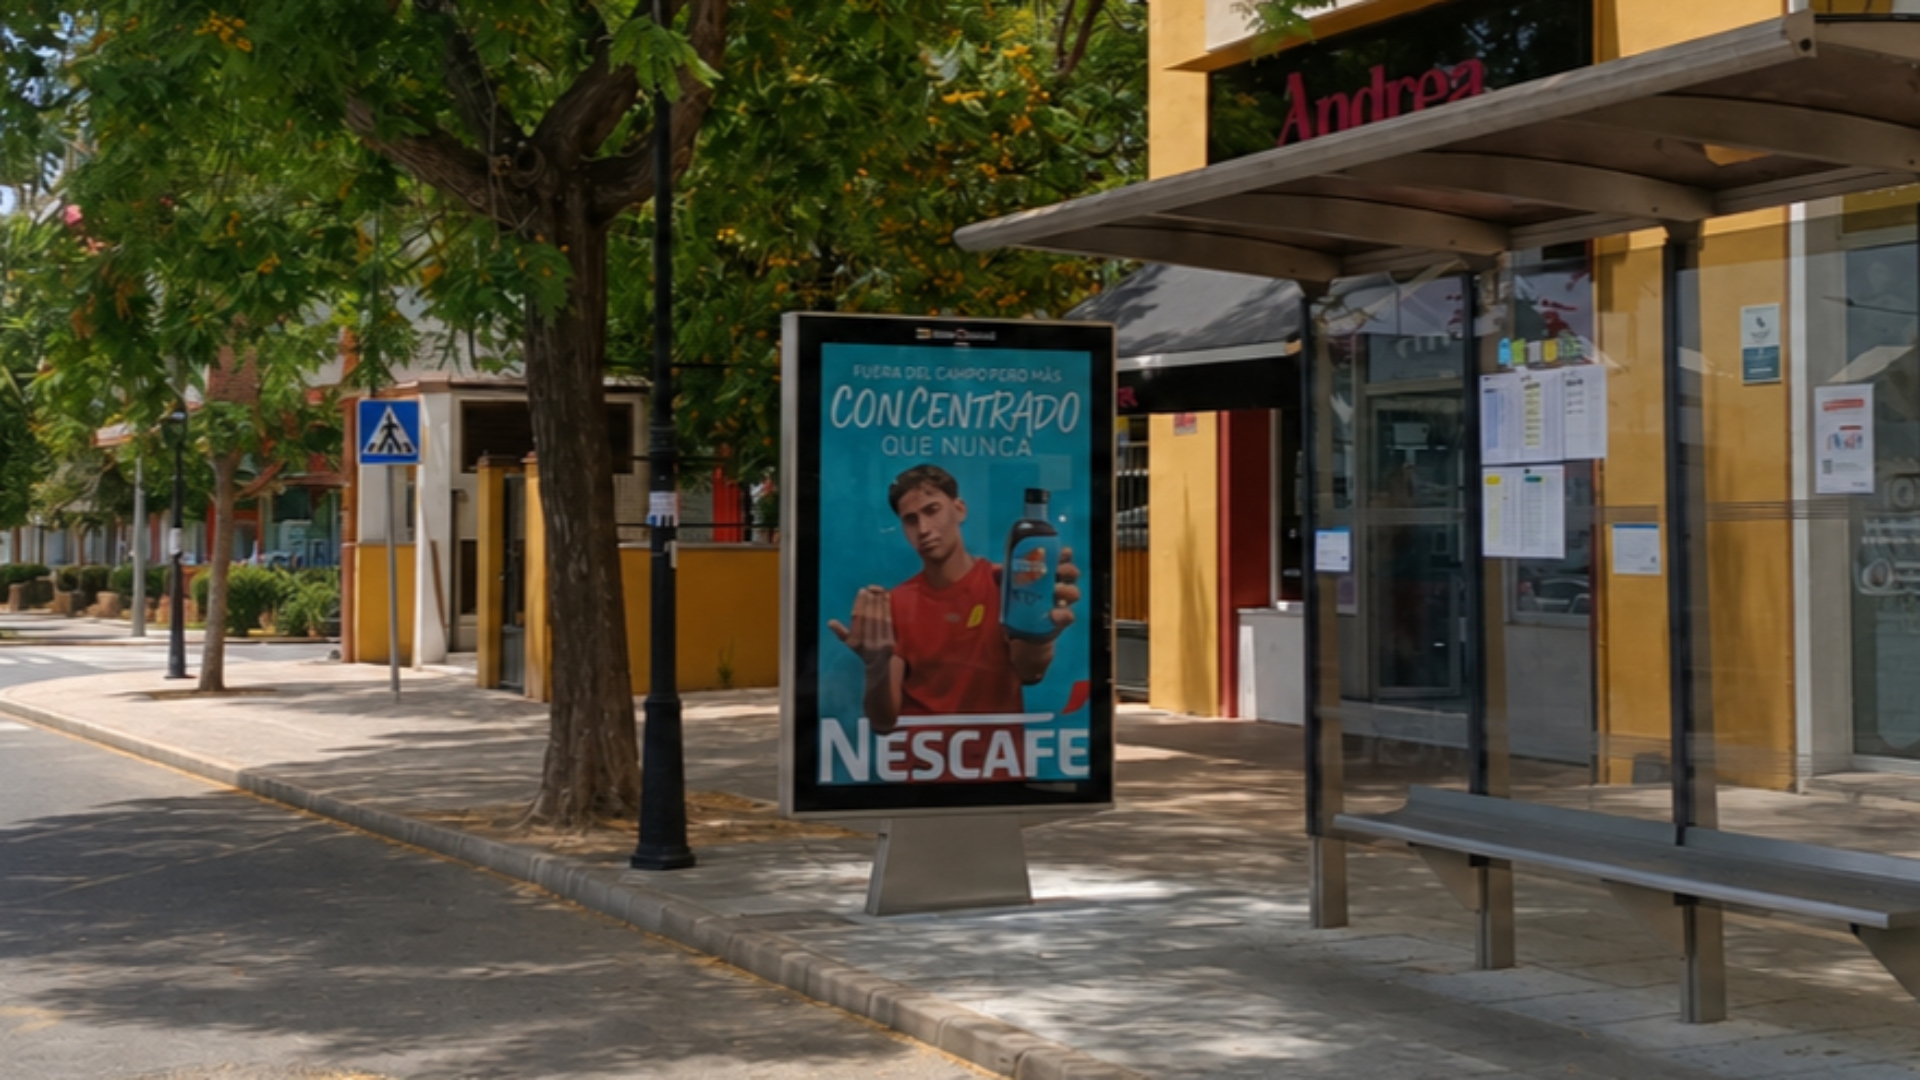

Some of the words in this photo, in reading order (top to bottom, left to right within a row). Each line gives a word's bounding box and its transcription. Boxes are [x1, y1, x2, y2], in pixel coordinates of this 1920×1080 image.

[1276, 58, 1484, 147] Andrea
[853, 363, 902, 379] FUERA
[905, 365, 932, 380] DEL
[935, 366, 987, 381] CAMPO
[989, 367, 1028, 382] PERO
[831, 385, 1080, 437] CONCENTRADO
[881, 434, 933, 456] QUE
[941, 435, 1032, 457] NUNCA
